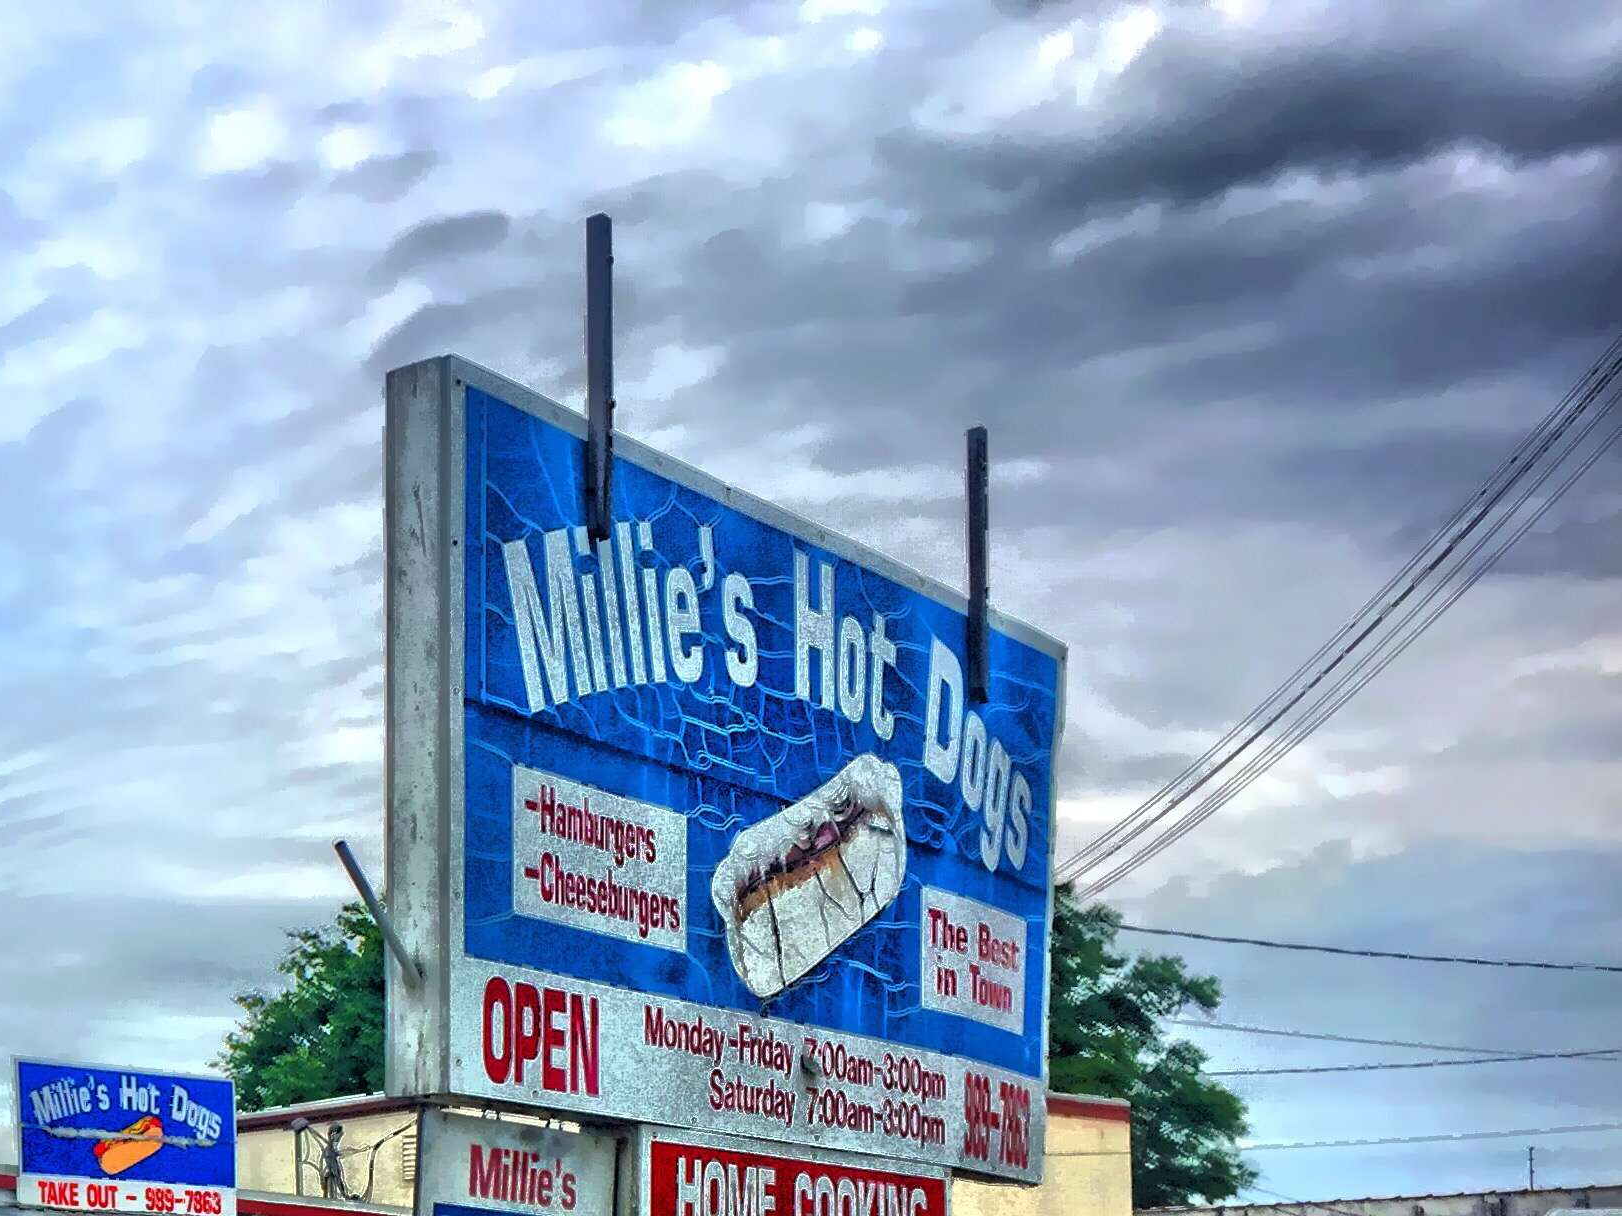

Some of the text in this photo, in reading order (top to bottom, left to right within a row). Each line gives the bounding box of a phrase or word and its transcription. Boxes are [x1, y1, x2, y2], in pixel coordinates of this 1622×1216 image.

[502, 521, 1033, 873] Millie's Hot Dogs
[927, 907, 1020, 973] The Best
[935, 954, 1014, 1015] in Town
[481, 974, 601, 1098] OPEN
[643, 1004, 948, 1104] Monday-Friday 7:00am-3:00pm
[30, 1074, 223, 1141] Millie's Hot Dogs
[708, 1067, 947, 1148] Saturday 7:00am-3:00pm
[38, 1180, 80, 1207] TAKE
[86, 1183, 118, 1209] OUT
[468, 1143, 577, 1211] Millie's
